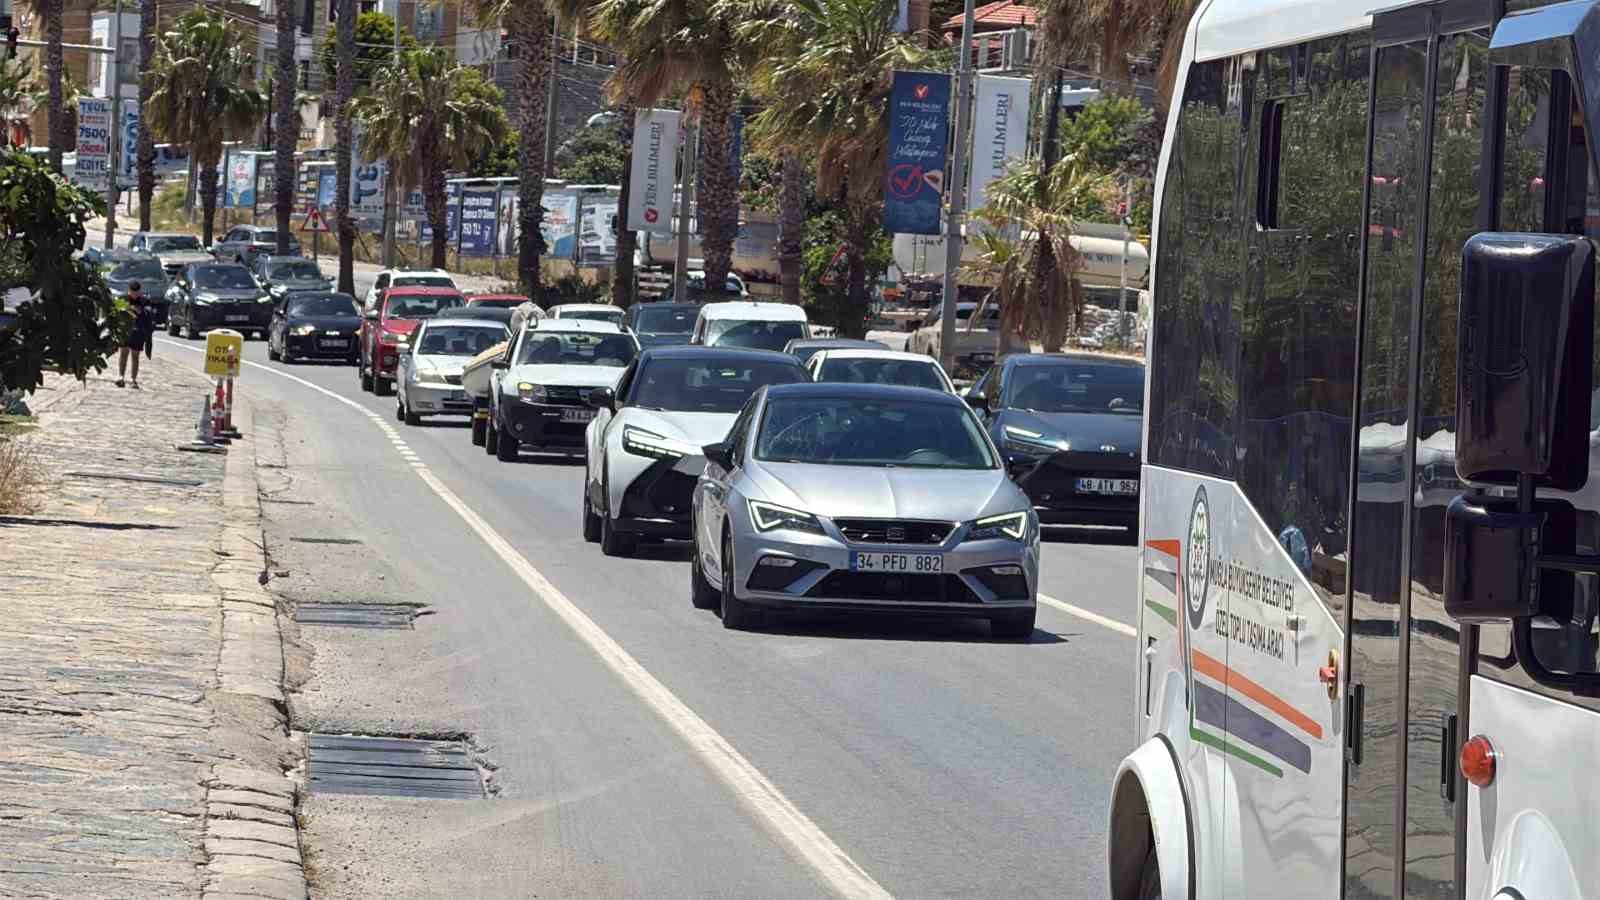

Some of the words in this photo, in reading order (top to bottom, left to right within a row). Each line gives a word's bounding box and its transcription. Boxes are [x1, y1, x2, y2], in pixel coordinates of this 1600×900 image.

[857, 554, 874, 569] 34
[882, 555, 907, 570] PFD
[916, 556, 940, 571] 882
[1210, 554, 1228, 590] MUĞLA
[1215, 601, 1229, 638] ÖZEL
[1230, 613, 1246, 645] TOPLU
